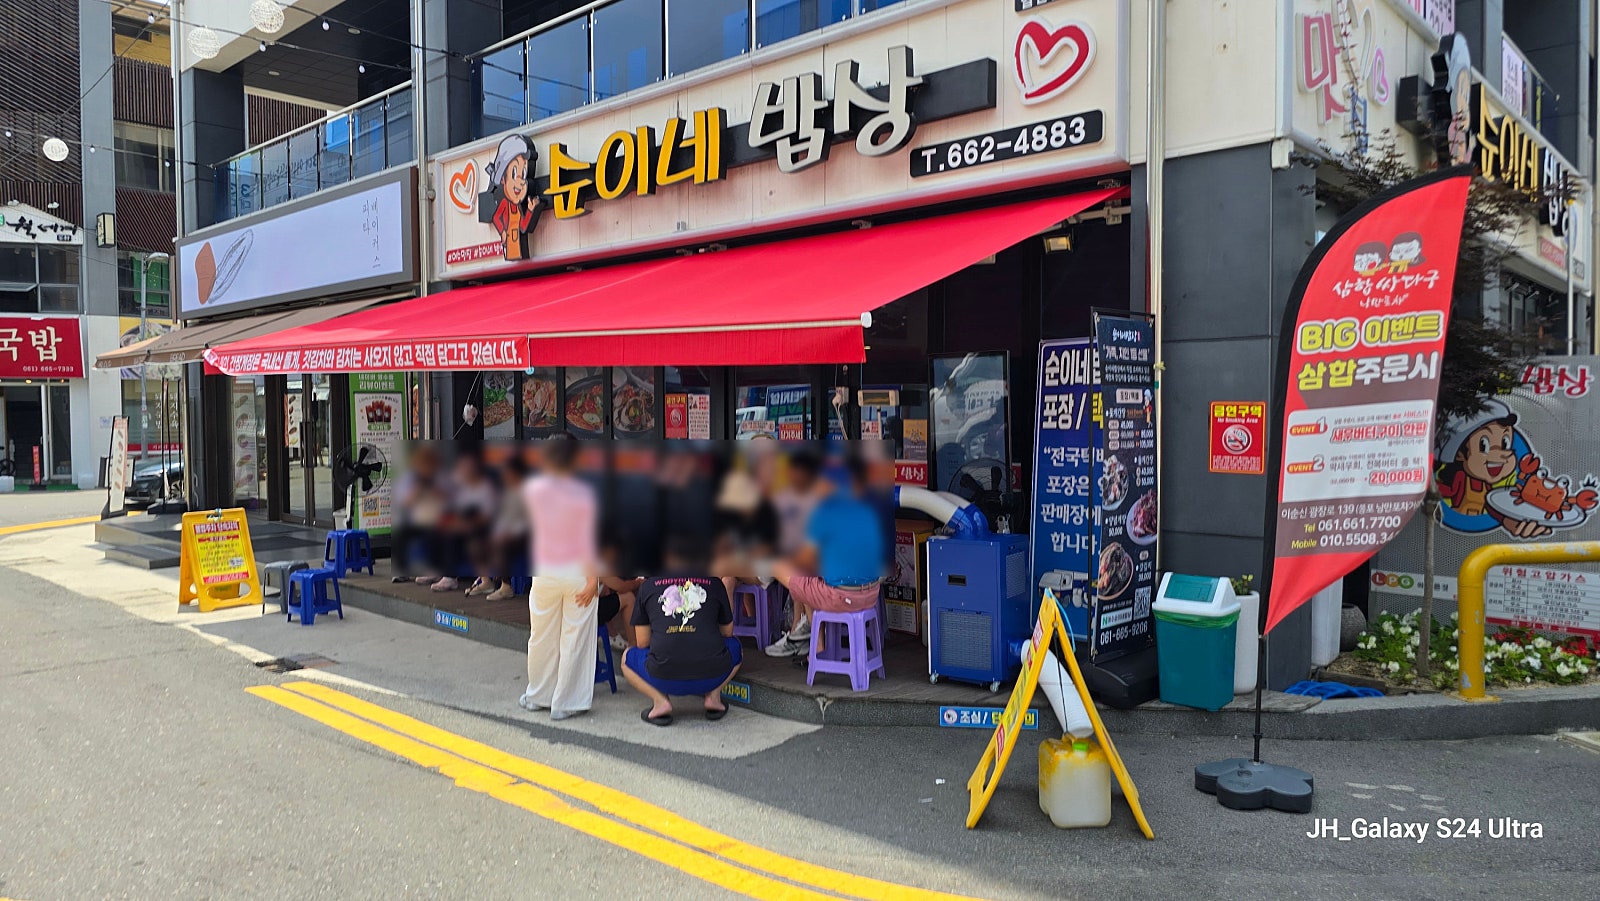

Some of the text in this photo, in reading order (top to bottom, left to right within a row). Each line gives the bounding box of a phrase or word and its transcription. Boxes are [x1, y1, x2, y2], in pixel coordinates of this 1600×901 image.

[543, 45, 924, 219] 순이네 밥상
[921, 117, 1087, 174] T.662-4883
[1299, 313, 1441, 352] BIG 이벤트
[0, 325, 63, 363] 국밥
[335, 346, 362, 368] 김치는
[363, 343, 392, 367] 사오지
[393, 344, 414, 367] 않고
[415, 343, 436, 366] 직접
[437, 342, 469, 366] 담그고
[471, 339, 523, 366] 있습니다.
[1214, 405, 1262, 418] 금연구역
[1291, 425, 1316, 434] EVENT
[1288, 462, 1312, 472] EVENT
[1369, 468, 1424, 486] 20,000원
[1281, 508, 1307, 520] 이순신
[1310, 503, 1335, 518] 광장로
[1337, 504, 1355, 515] 139
[1303, 515, 1401, 533] Tel 061.661.7700
[1291, 540, 1318, 549] Mobile
